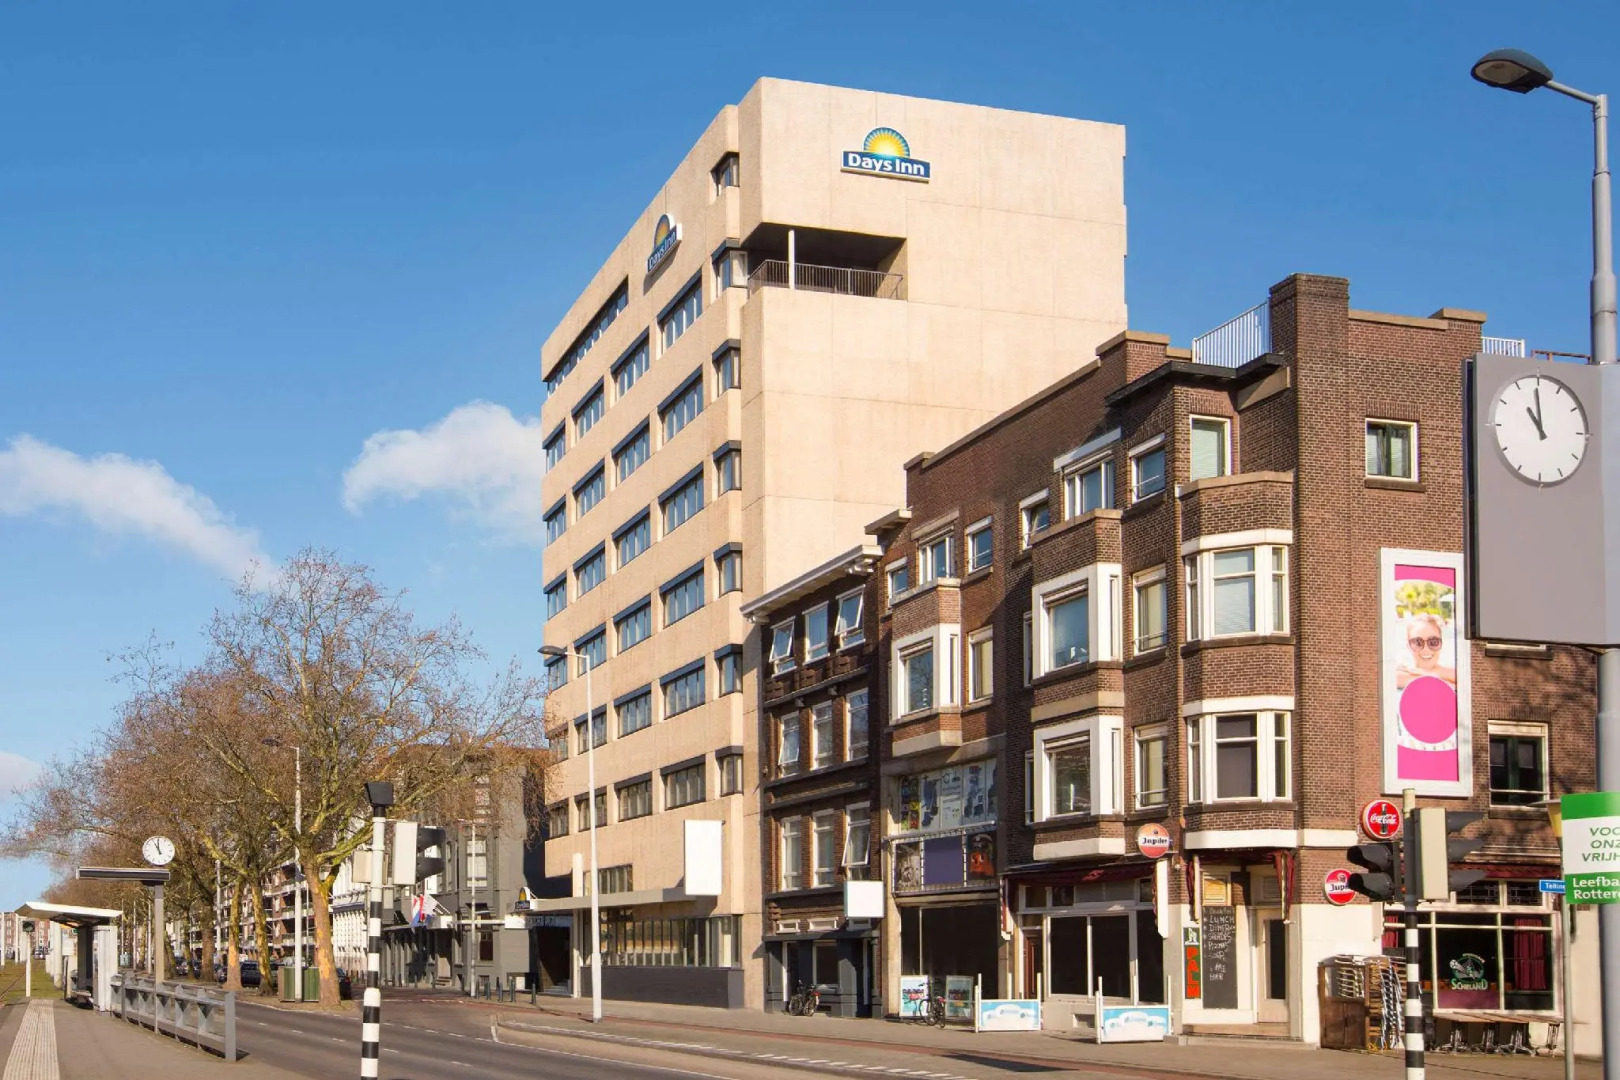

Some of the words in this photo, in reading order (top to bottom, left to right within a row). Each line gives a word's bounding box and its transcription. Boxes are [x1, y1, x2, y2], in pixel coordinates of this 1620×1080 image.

[848, 152, 893, 172] Days
[895, 158, 925, 176] Inn
[649, 245, 665, 270] Days
[664, 231, 676, 252] Inn
[1143, 837, 1168, 845] Jupiler
[1186, 946, 1200, 998] PALM
